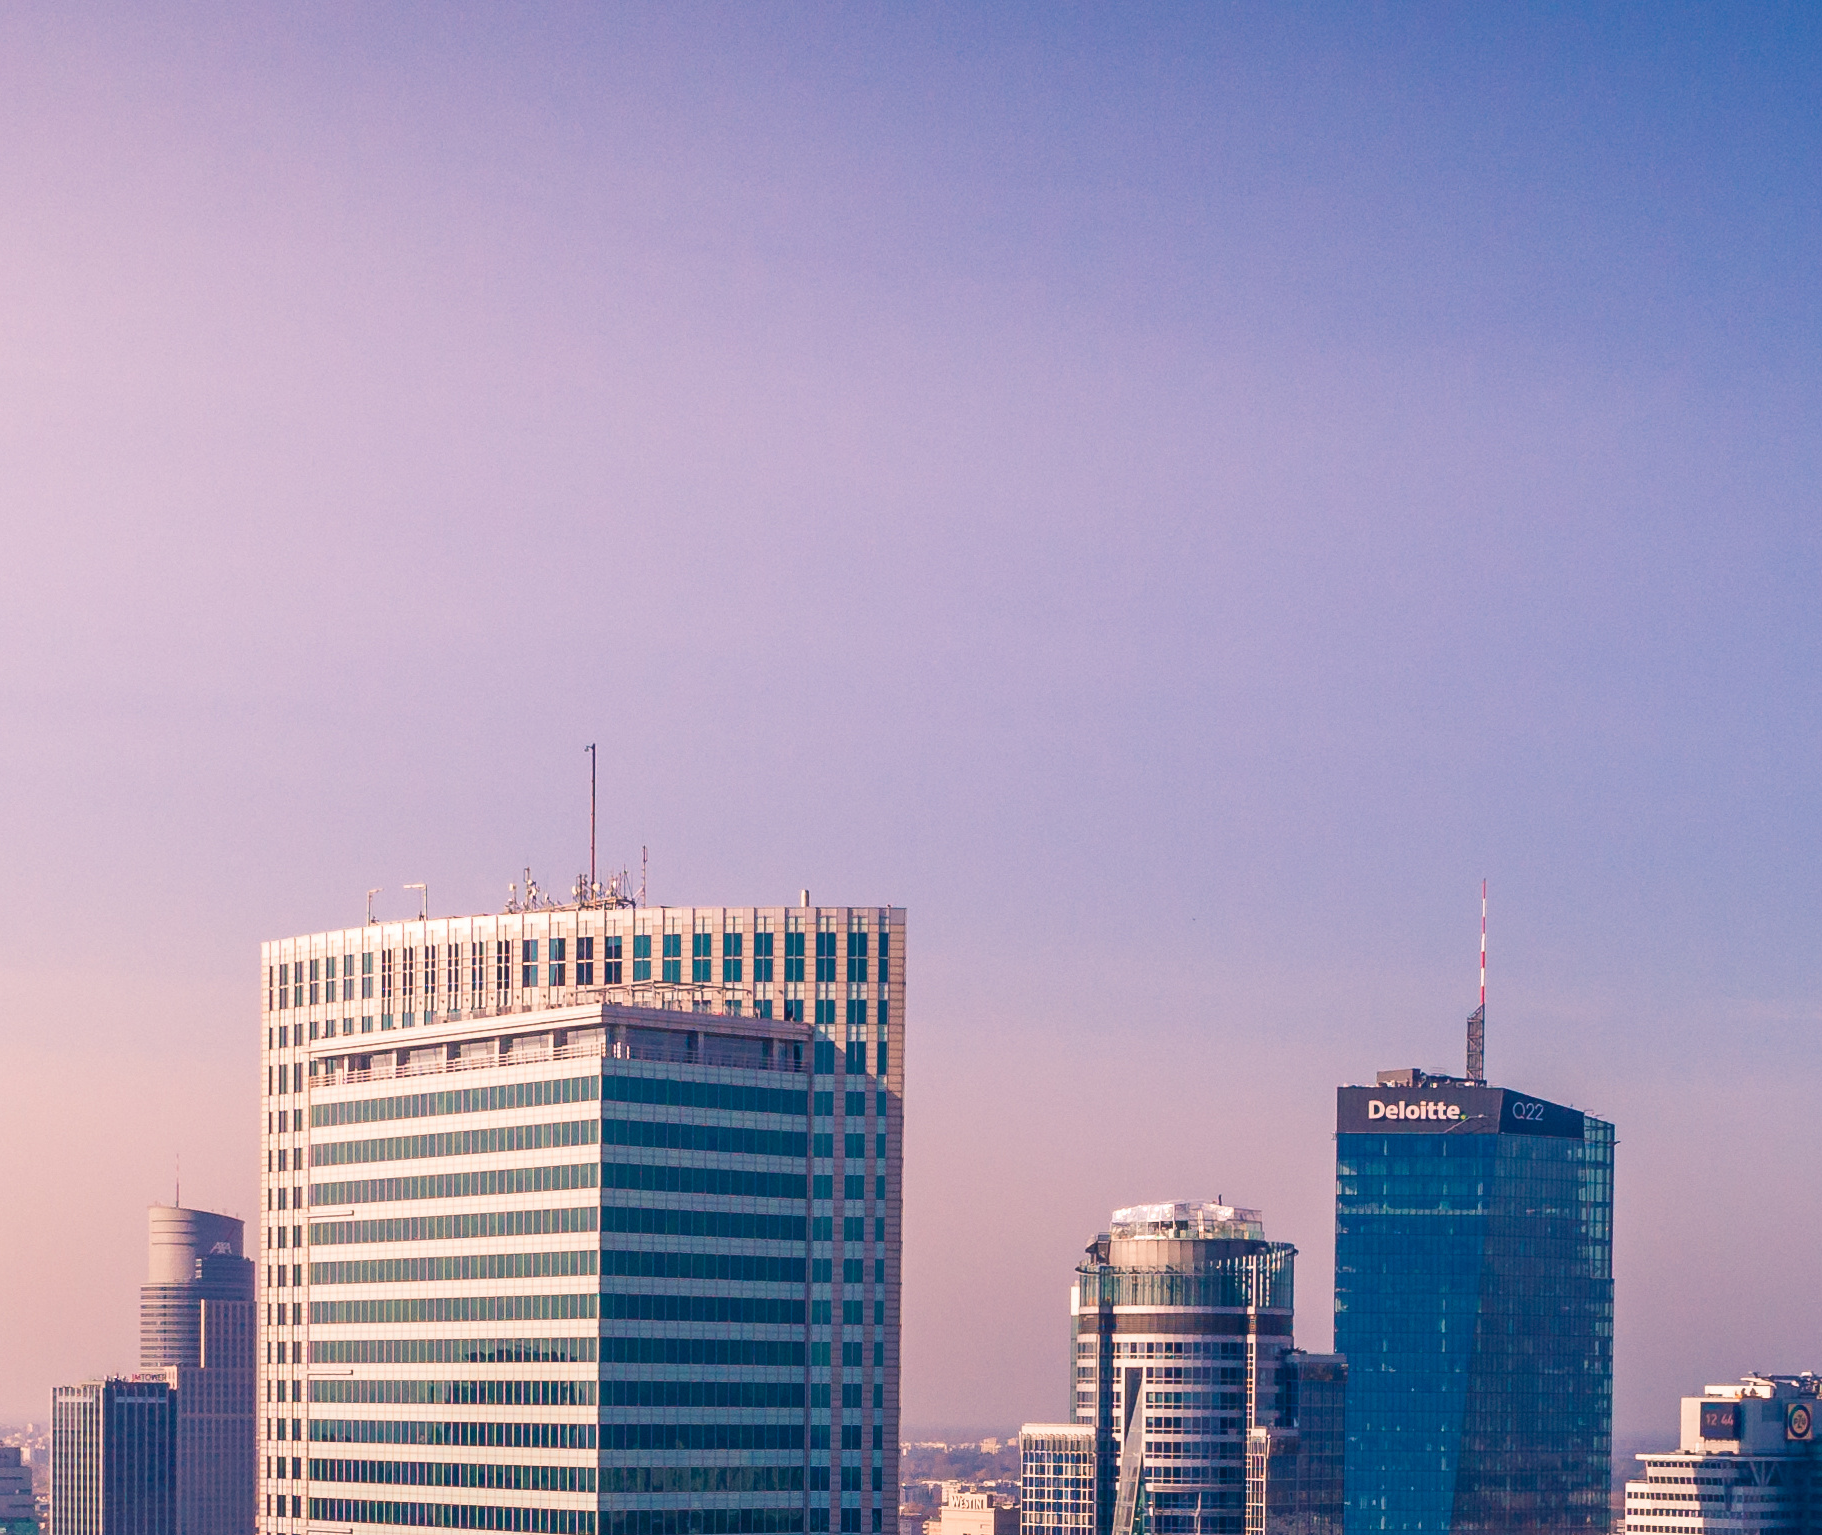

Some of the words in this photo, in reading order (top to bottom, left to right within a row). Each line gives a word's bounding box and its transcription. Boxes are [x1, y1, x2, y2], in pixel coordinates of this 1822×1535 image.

[1512, 1101, 1544, 1121] Q22
[210, 1242, 232, 1255] AXA
[1794, 1414, 1806, 1429] PZU
[951, 1495, 984, 1510] WESTIN
